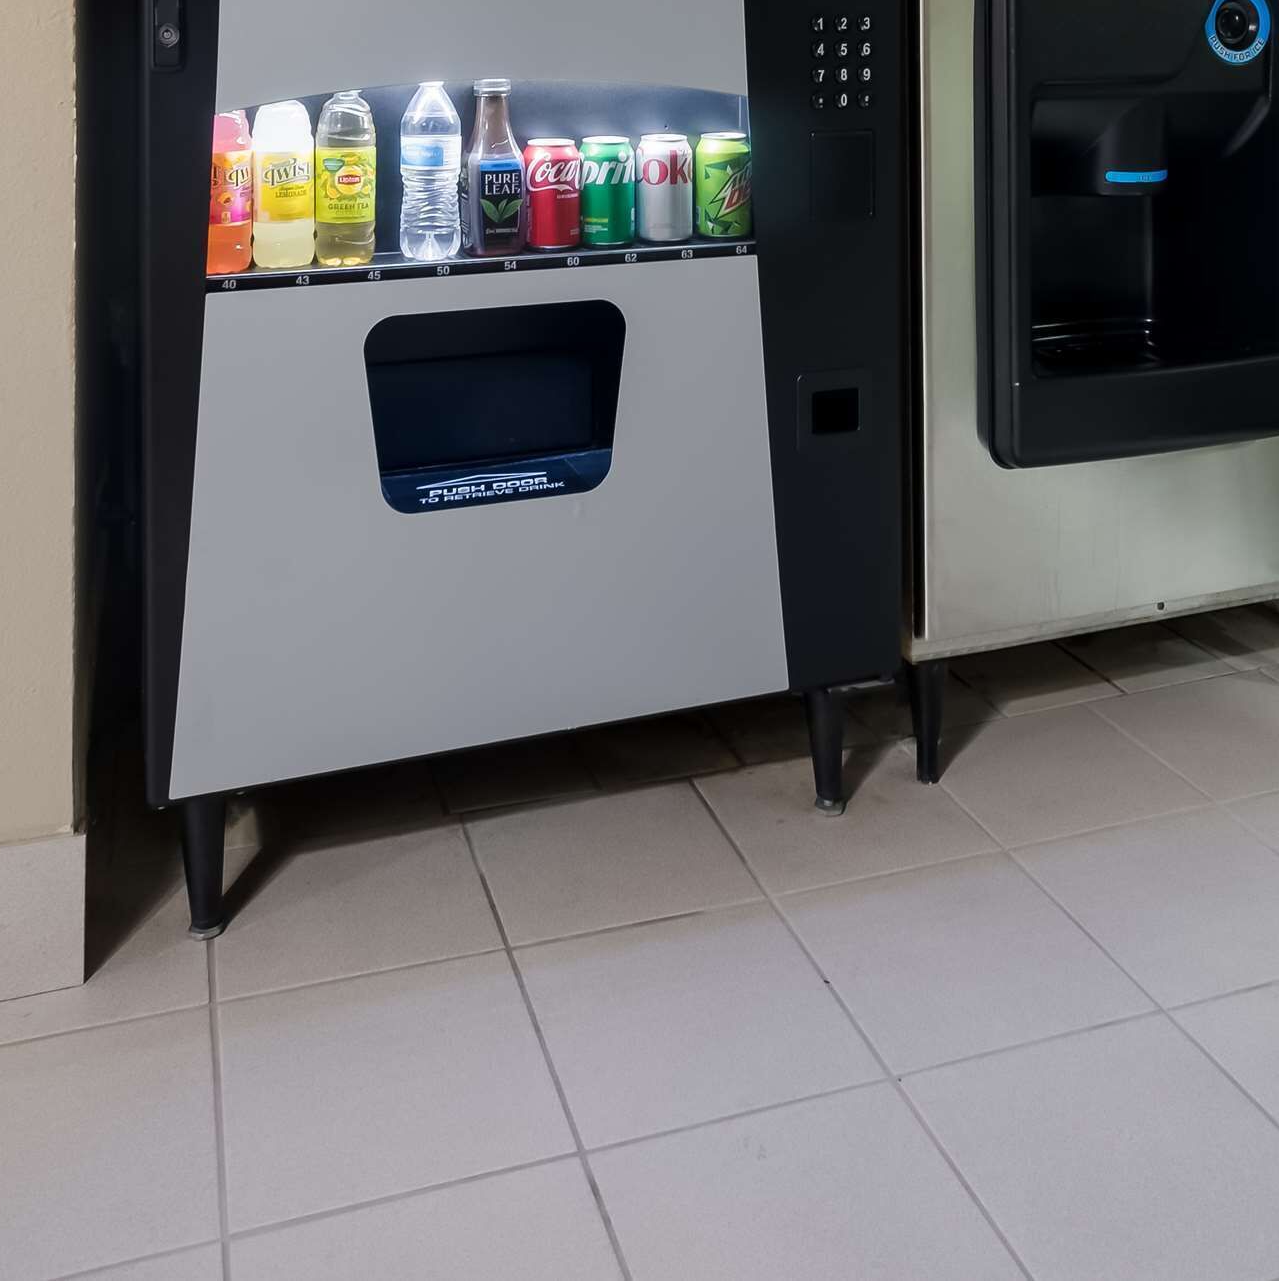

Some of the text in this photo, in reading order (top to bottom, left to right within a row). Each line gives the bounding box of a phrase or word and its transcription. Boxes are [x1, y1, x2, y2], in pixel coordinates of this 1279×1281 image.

[817, 17, 870, 30] 1 2 3
[817, 43, 871, 56] 4 5 6
[1208, 34, 1266, 62] PUSH FOR ICE
[817, 68, 871, 82] 7 8 9
[841, 94, 848, 106] 0
[485, 172, 520, 184] PURE
[485, 184, 520, 195] LEAF
[357, 202, 370, 210] TEA
[222, 245, 748, 289] 40 43 45 50 54 60 62 63 64
[419, 481, 565, 505] TO RETRIEVE DRINK
[429, 476, 548, 497] PUSH DOOR
